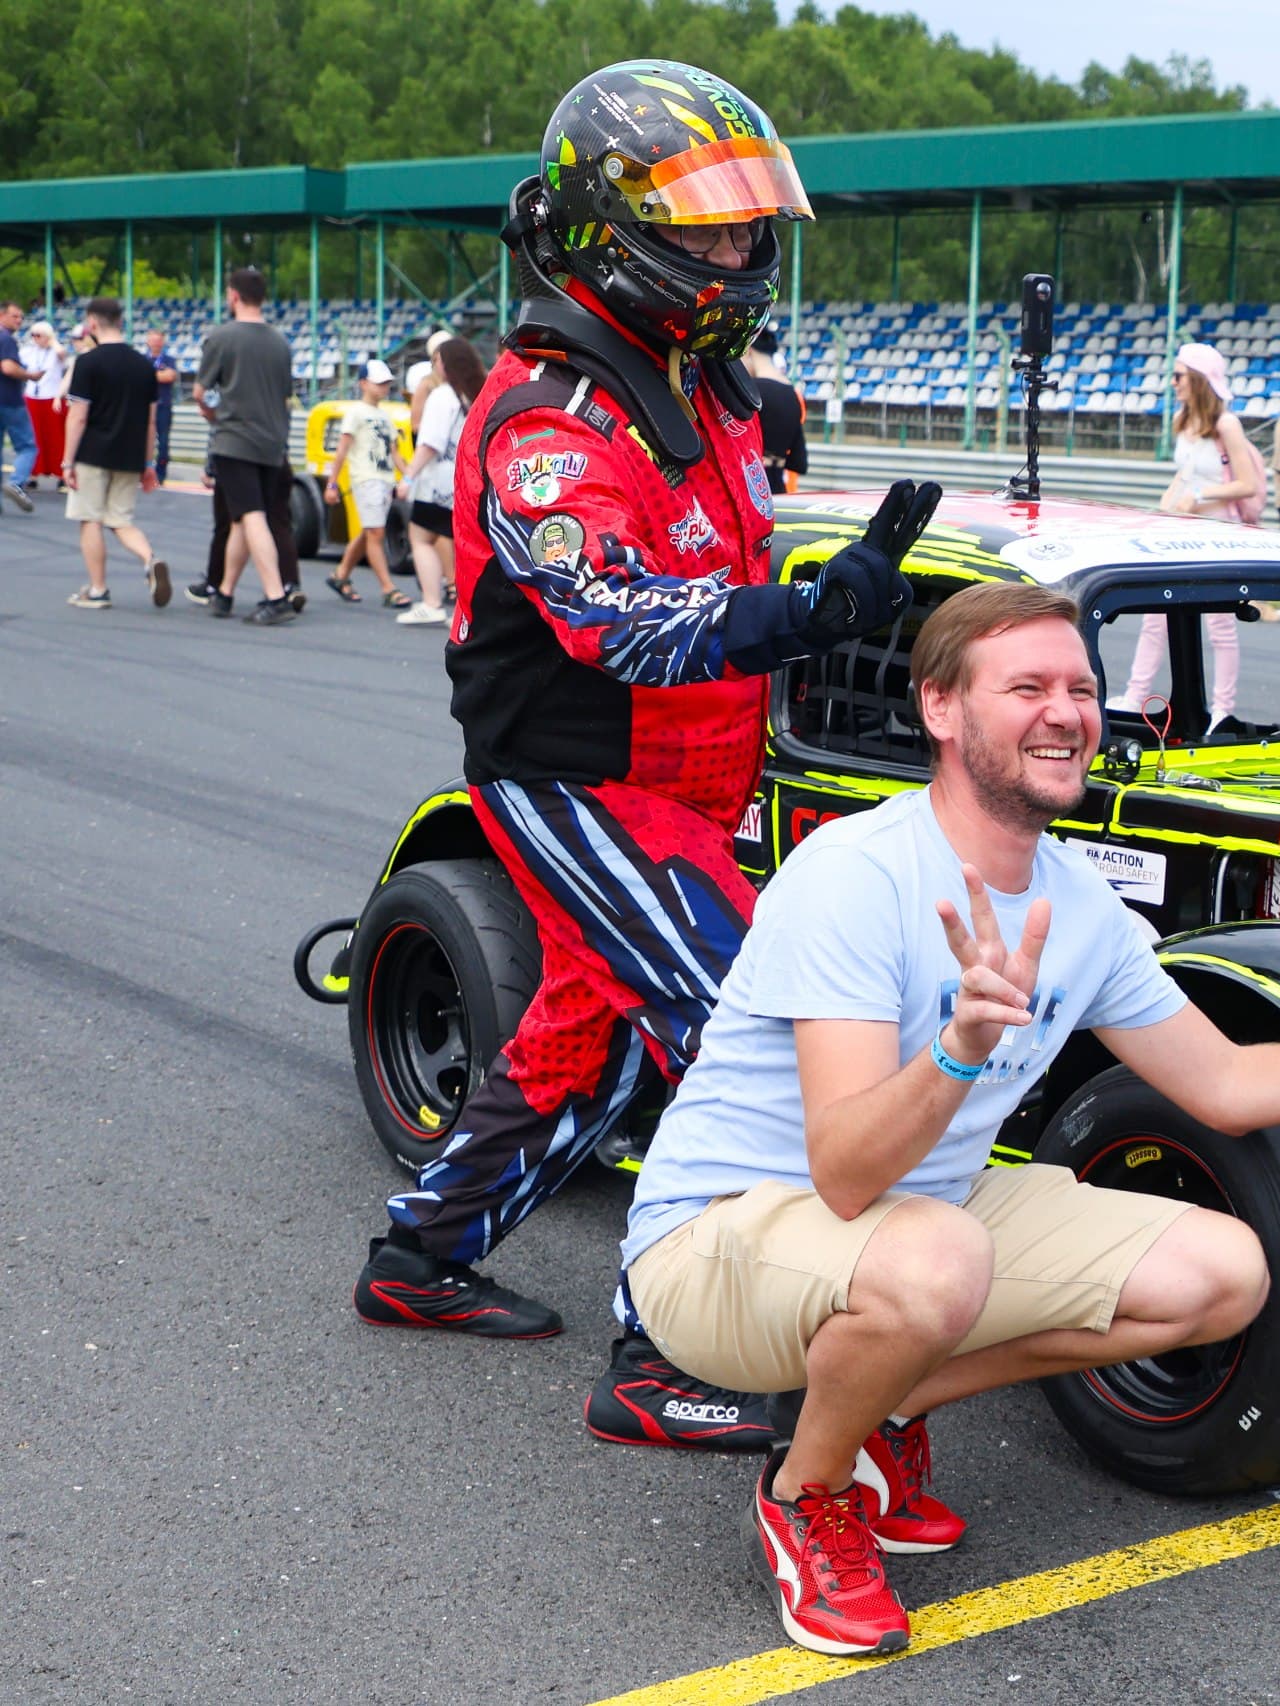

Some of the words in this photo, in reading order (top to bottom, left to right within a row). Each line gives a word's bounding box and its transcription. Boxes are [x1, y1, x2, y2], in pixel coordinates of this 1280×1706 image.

[1155, 538, 1204, 551] SMP
[1086, 848, 1100, 859] FIA
[1103, 849, 1144, 869] ACTION
[1099, 862, 1125, 876] ROAD
[1126, 868, 1160, 882] SAFETY
[663, 1400, 740, 1422] sparco
